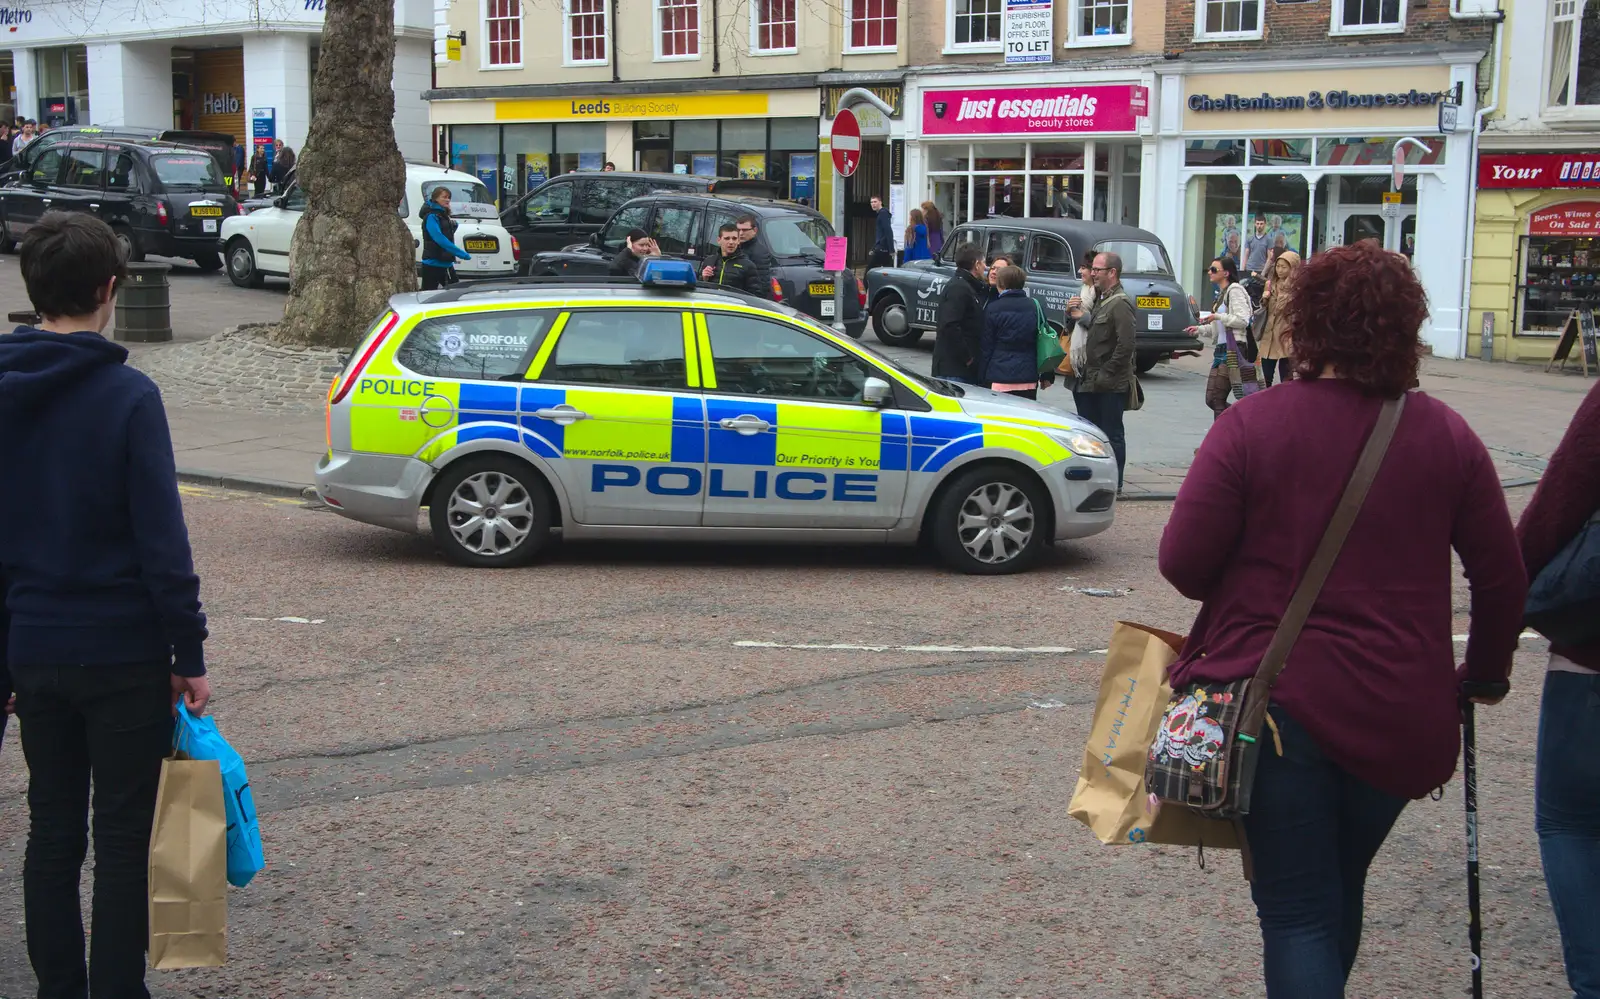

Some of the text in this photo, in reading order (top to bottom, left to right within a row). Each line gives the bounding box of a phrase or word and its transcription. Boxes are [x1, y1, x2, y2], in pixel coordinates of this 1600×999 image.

[1007, 11, 1051, 20] REFURBISHED
[1007, 30, 1029, 38] OFFICE
[1008, 41, 1049, 52] TO LET
[203, 92, 241, 114] Hello
[1188, 89, 1442, 111] Cheltenham & Gloucester
[571, 100, 680, 116] Leeds Building Society
[956, 97, 996, 121] just
[998, 94, 1098, 118] essentials
[1028, 117, 1094, 128] beauty stores
[1492, 165, 1543, 179] Your
[1534, 213, 1562, 223] Beers,
[1564, 210, 1592, 218] Wines
[1549, 220, 1565, 229] On
[1567, 220, 1591, 229] Sale
[1137, 298, 1169, 307] K228 EFL
[469, 334, 528, 345] NORFOLK
[361, 379, 436, 397] POLICE
[564, 447, 670, 460] www.norfolk.police.uk
[776, 453, 880, 467] Our Priority is You
[591, 463, 879, 502] POLICE
